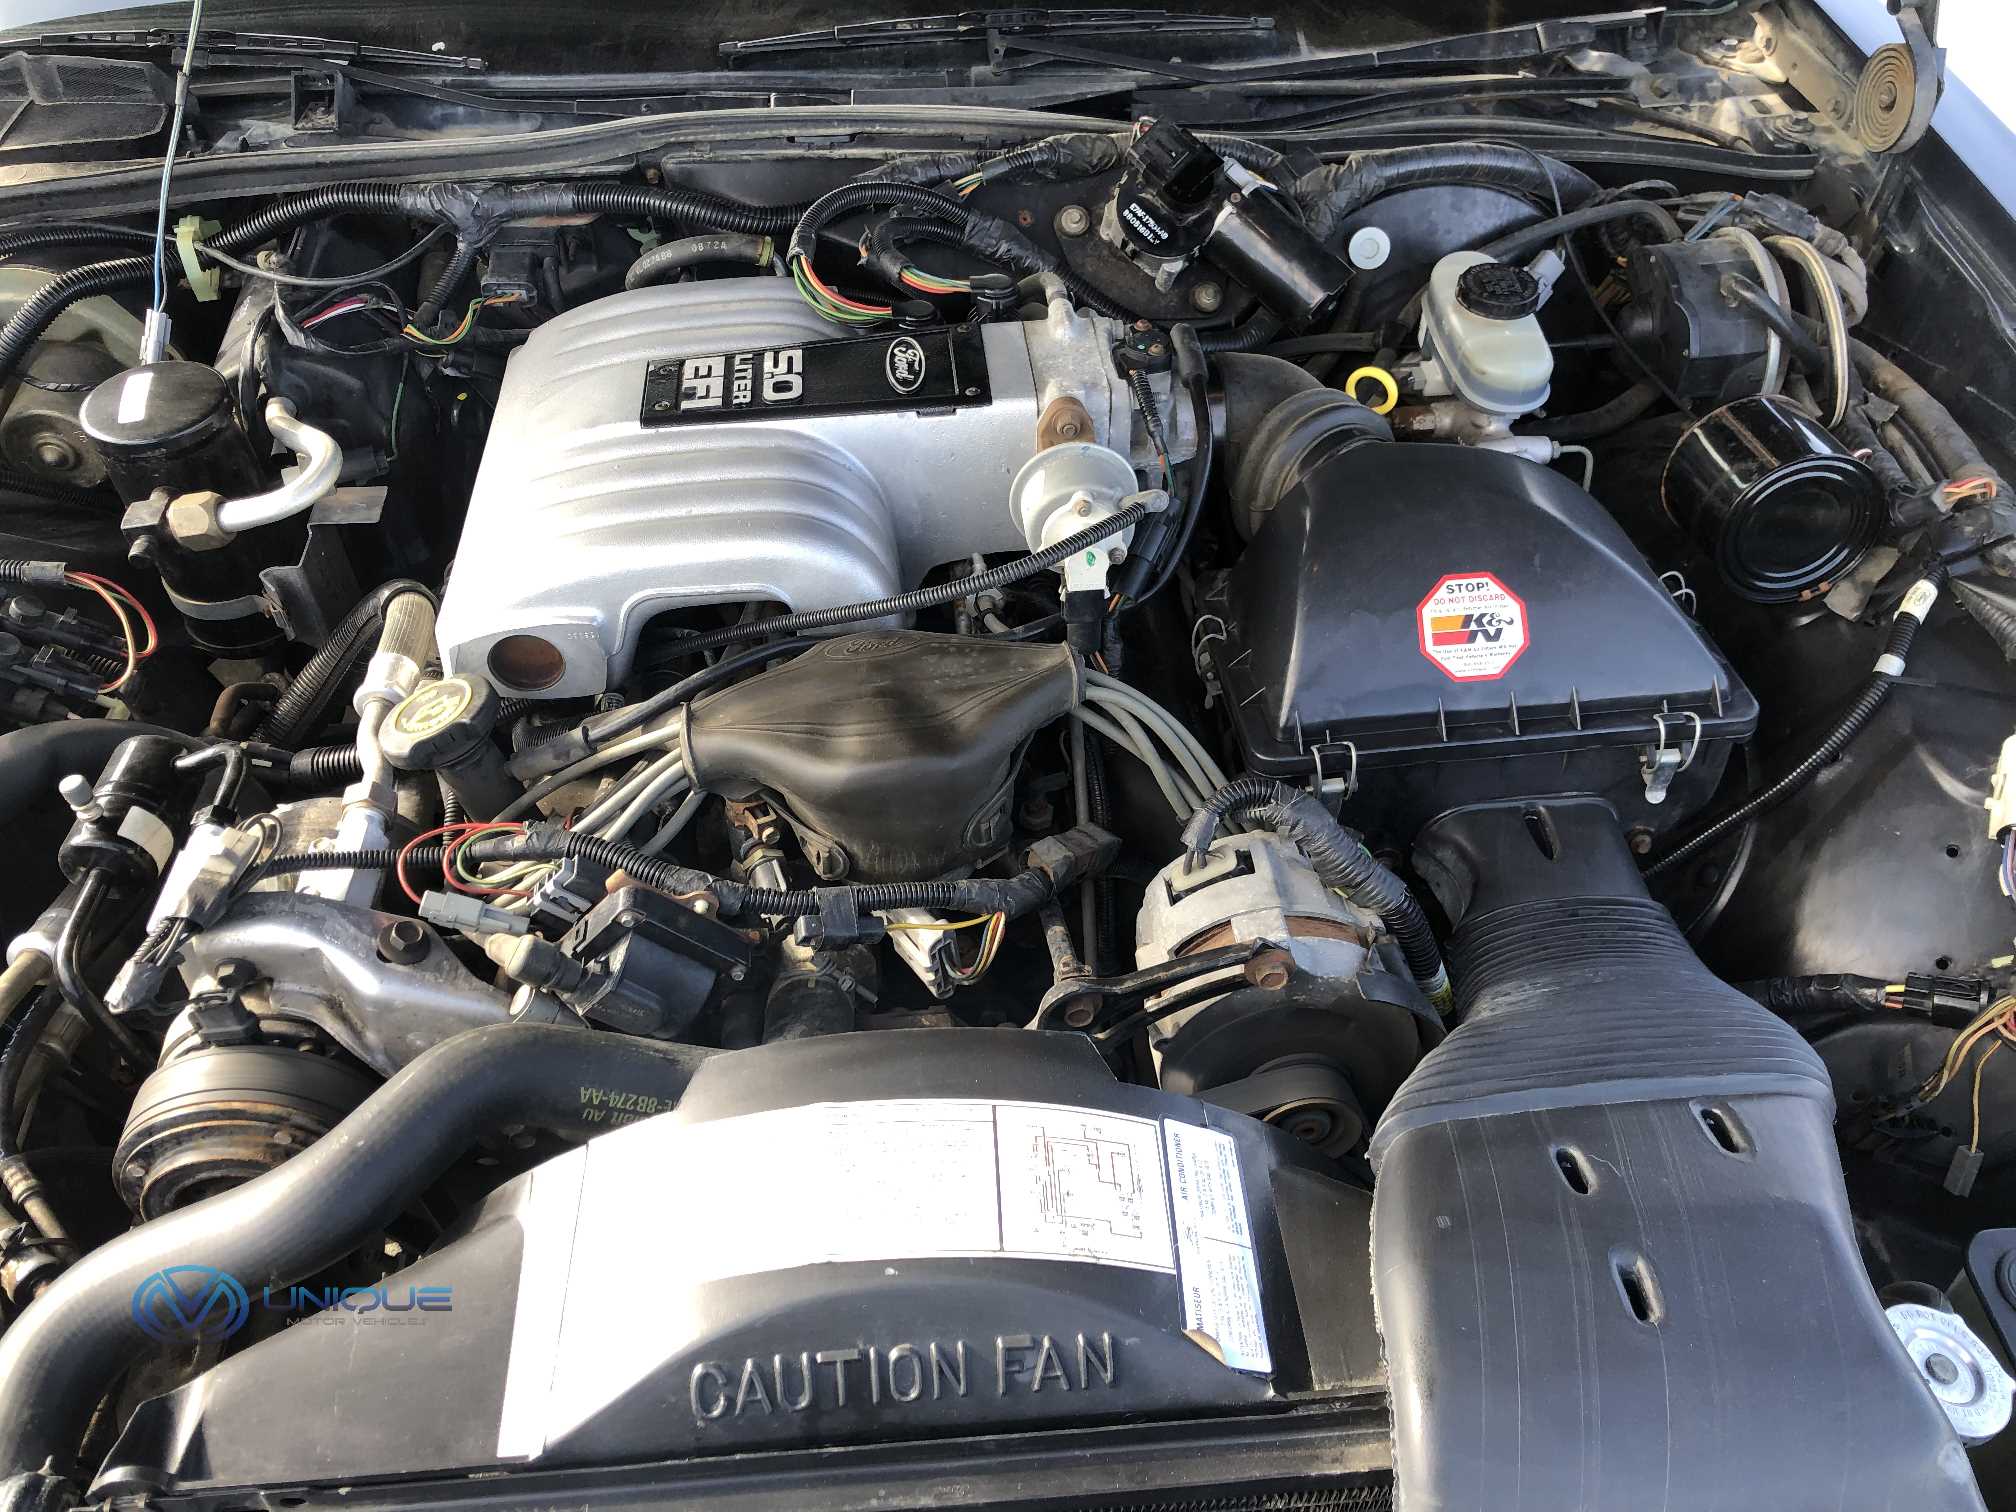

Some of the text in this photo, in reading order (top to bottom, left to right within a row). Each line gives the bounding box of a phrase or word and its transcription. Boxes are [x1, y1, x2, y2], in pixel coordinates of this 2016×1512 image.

[680, 355, 726, 411] EFI
[732, 352, 754, 408] LITER
[1433, 593, 1506, 606] DO NOT DISCARD
[1445, 582, 1490, 595] STOP!
[1173, 1131, 1187, 1184] CONDITIONER
[1192, 1286, 1204, 1331] MATISEUR
[688, 1331, 1116, 1422] CAUTION FAN
